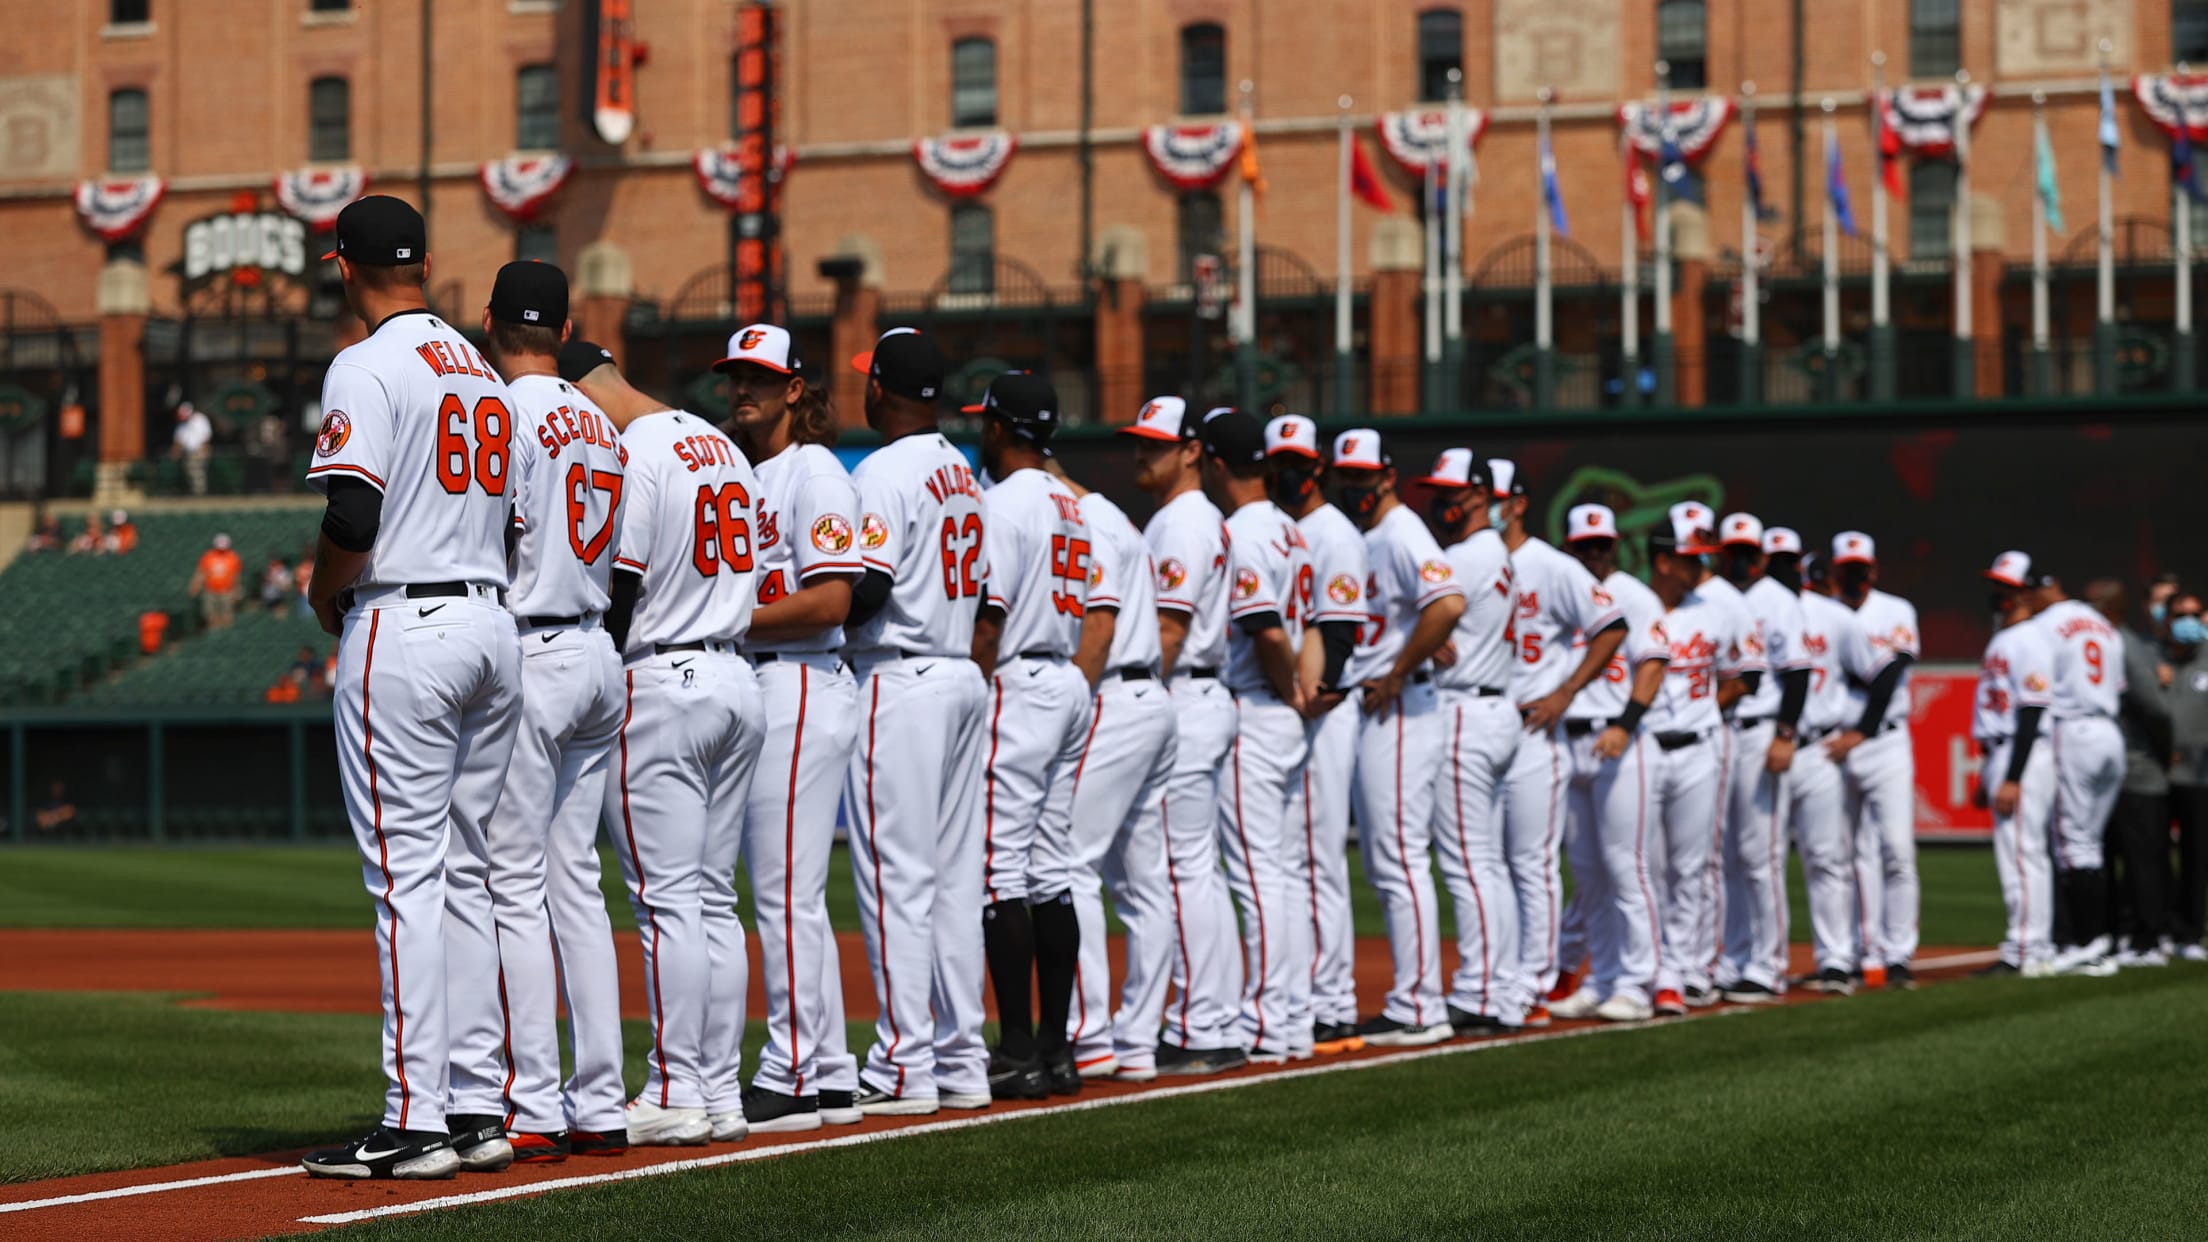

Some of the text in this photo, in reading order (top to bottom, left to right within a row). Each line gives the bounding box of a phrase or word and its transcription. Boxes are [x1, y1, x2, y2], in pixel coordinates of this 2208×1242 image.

[437, 393, 512, 496] 68
[673, 434, 736, 473] SCOTT
[566, 462, 624, 566] 67
[693, 482, 754, 578] 66
[941, 512, 983, 602] 62
[1052, 534, 1091, 618] 55
[2084, 640, 2102, 686] 9
